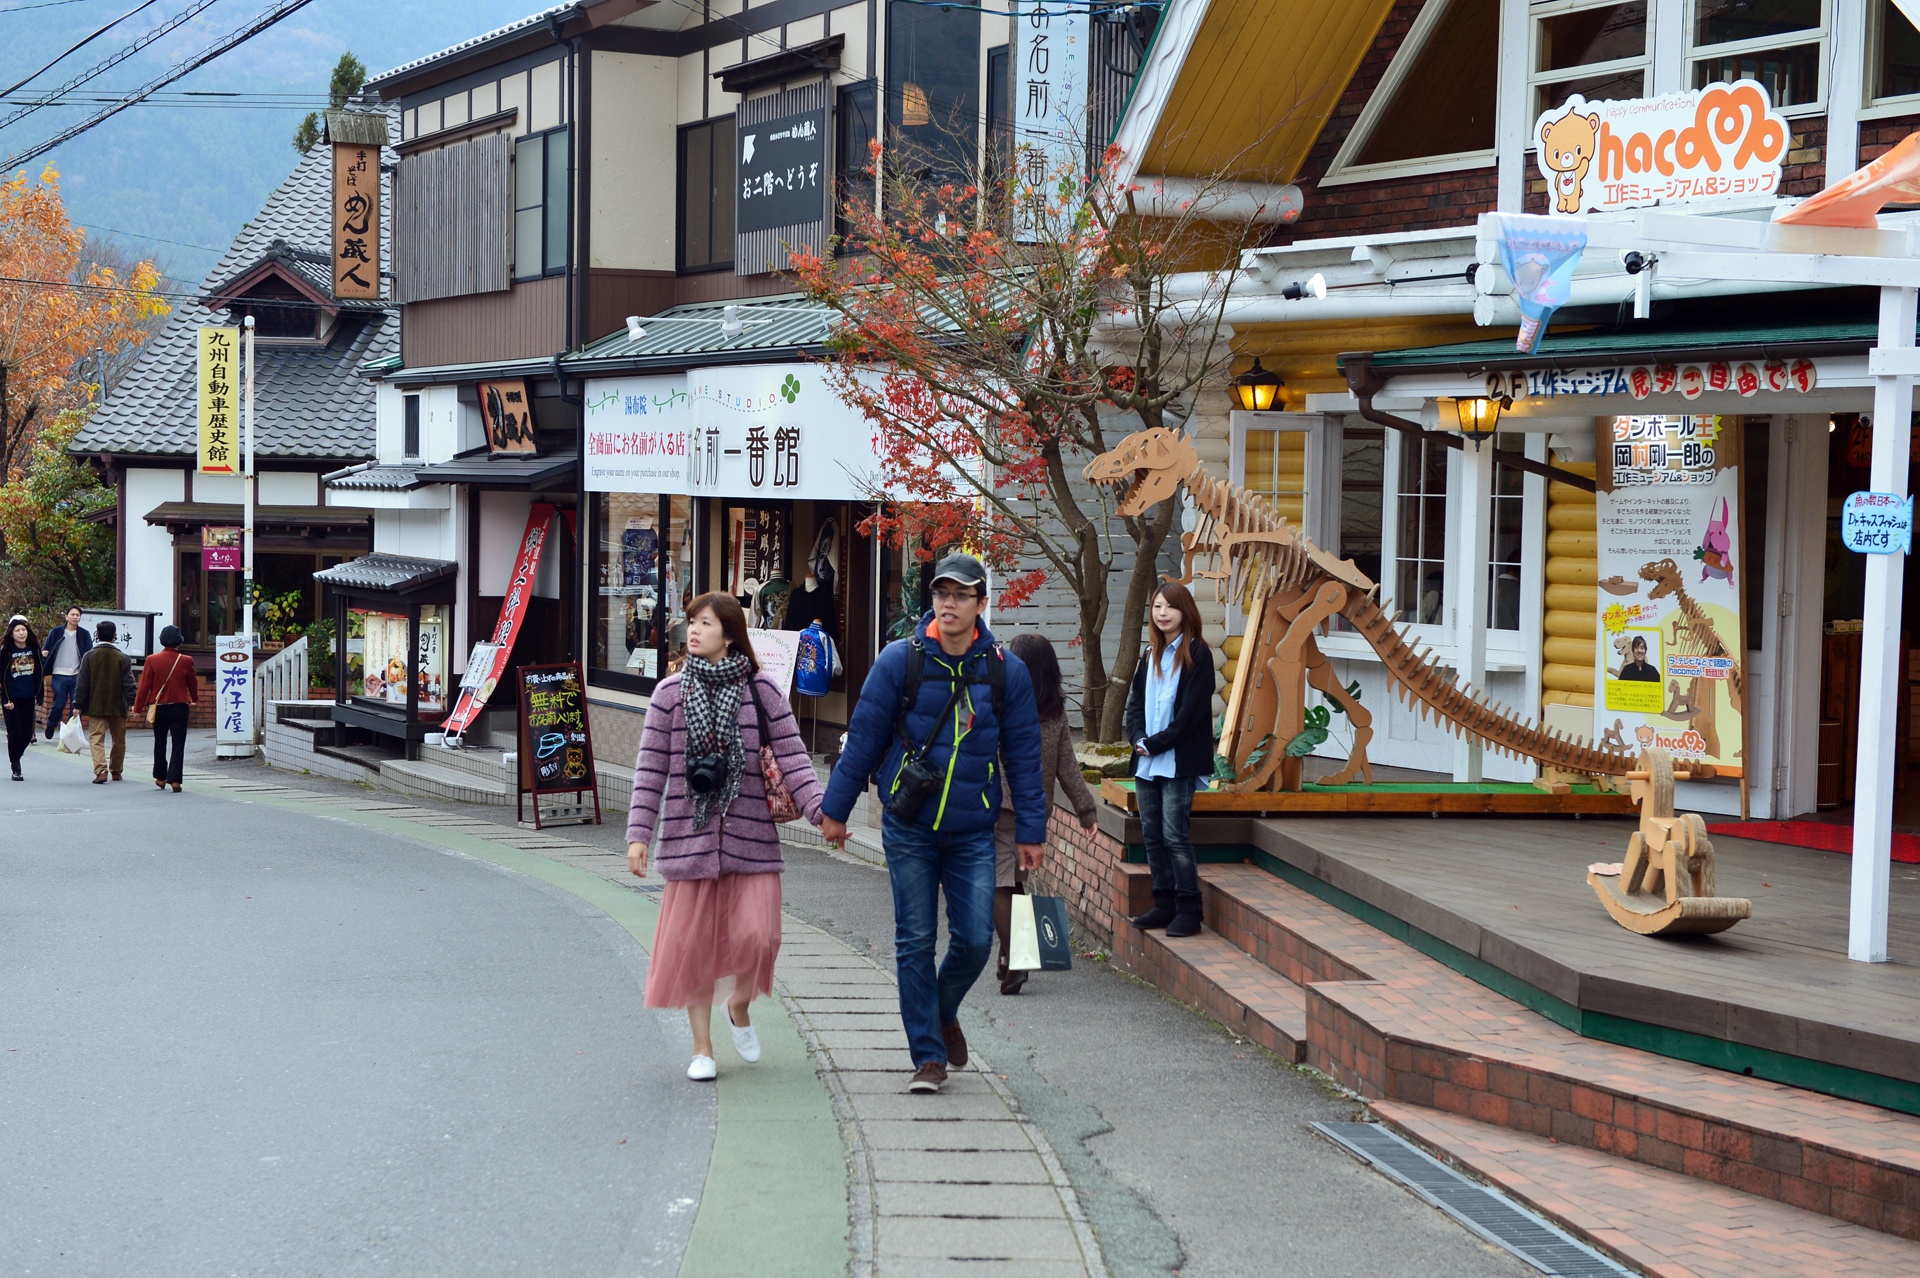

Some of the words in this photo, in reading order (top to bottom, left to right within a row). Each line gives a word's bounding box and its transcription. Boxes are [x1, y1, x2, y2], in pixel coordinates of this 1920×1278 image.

[1597, 85, 1785, 183] hacomo
[355, 150, 368, 173] 手打
[346, 165, 358, 188] そば
[742, 161, 819, 200] お二階へどうぞ
[1603, 170, 1777, 206] 工作ミュージアム&ショップ
[339, 189, 375, 290] めん蔵人
[207, 331, 231, 462] 九州自動車歴史館
[624, 395, 648, 416] 湯布院
[1615, 414, 1714, 439] ダンボール王
[587, 431, 686, 456] 全商品にお名前が入る店
[1614, 443, 1714, 467] 岡村剛一郎の
[687, 426, 801, 488] 名前一番館
[1614, 471, 1714, 484] 工作ミュージアム&ショップ
[1852, 528, 1891, 549] 店内です
[221, 665, 249, 734] 茄子屋
[530, 690, 578, 712] 無料で
